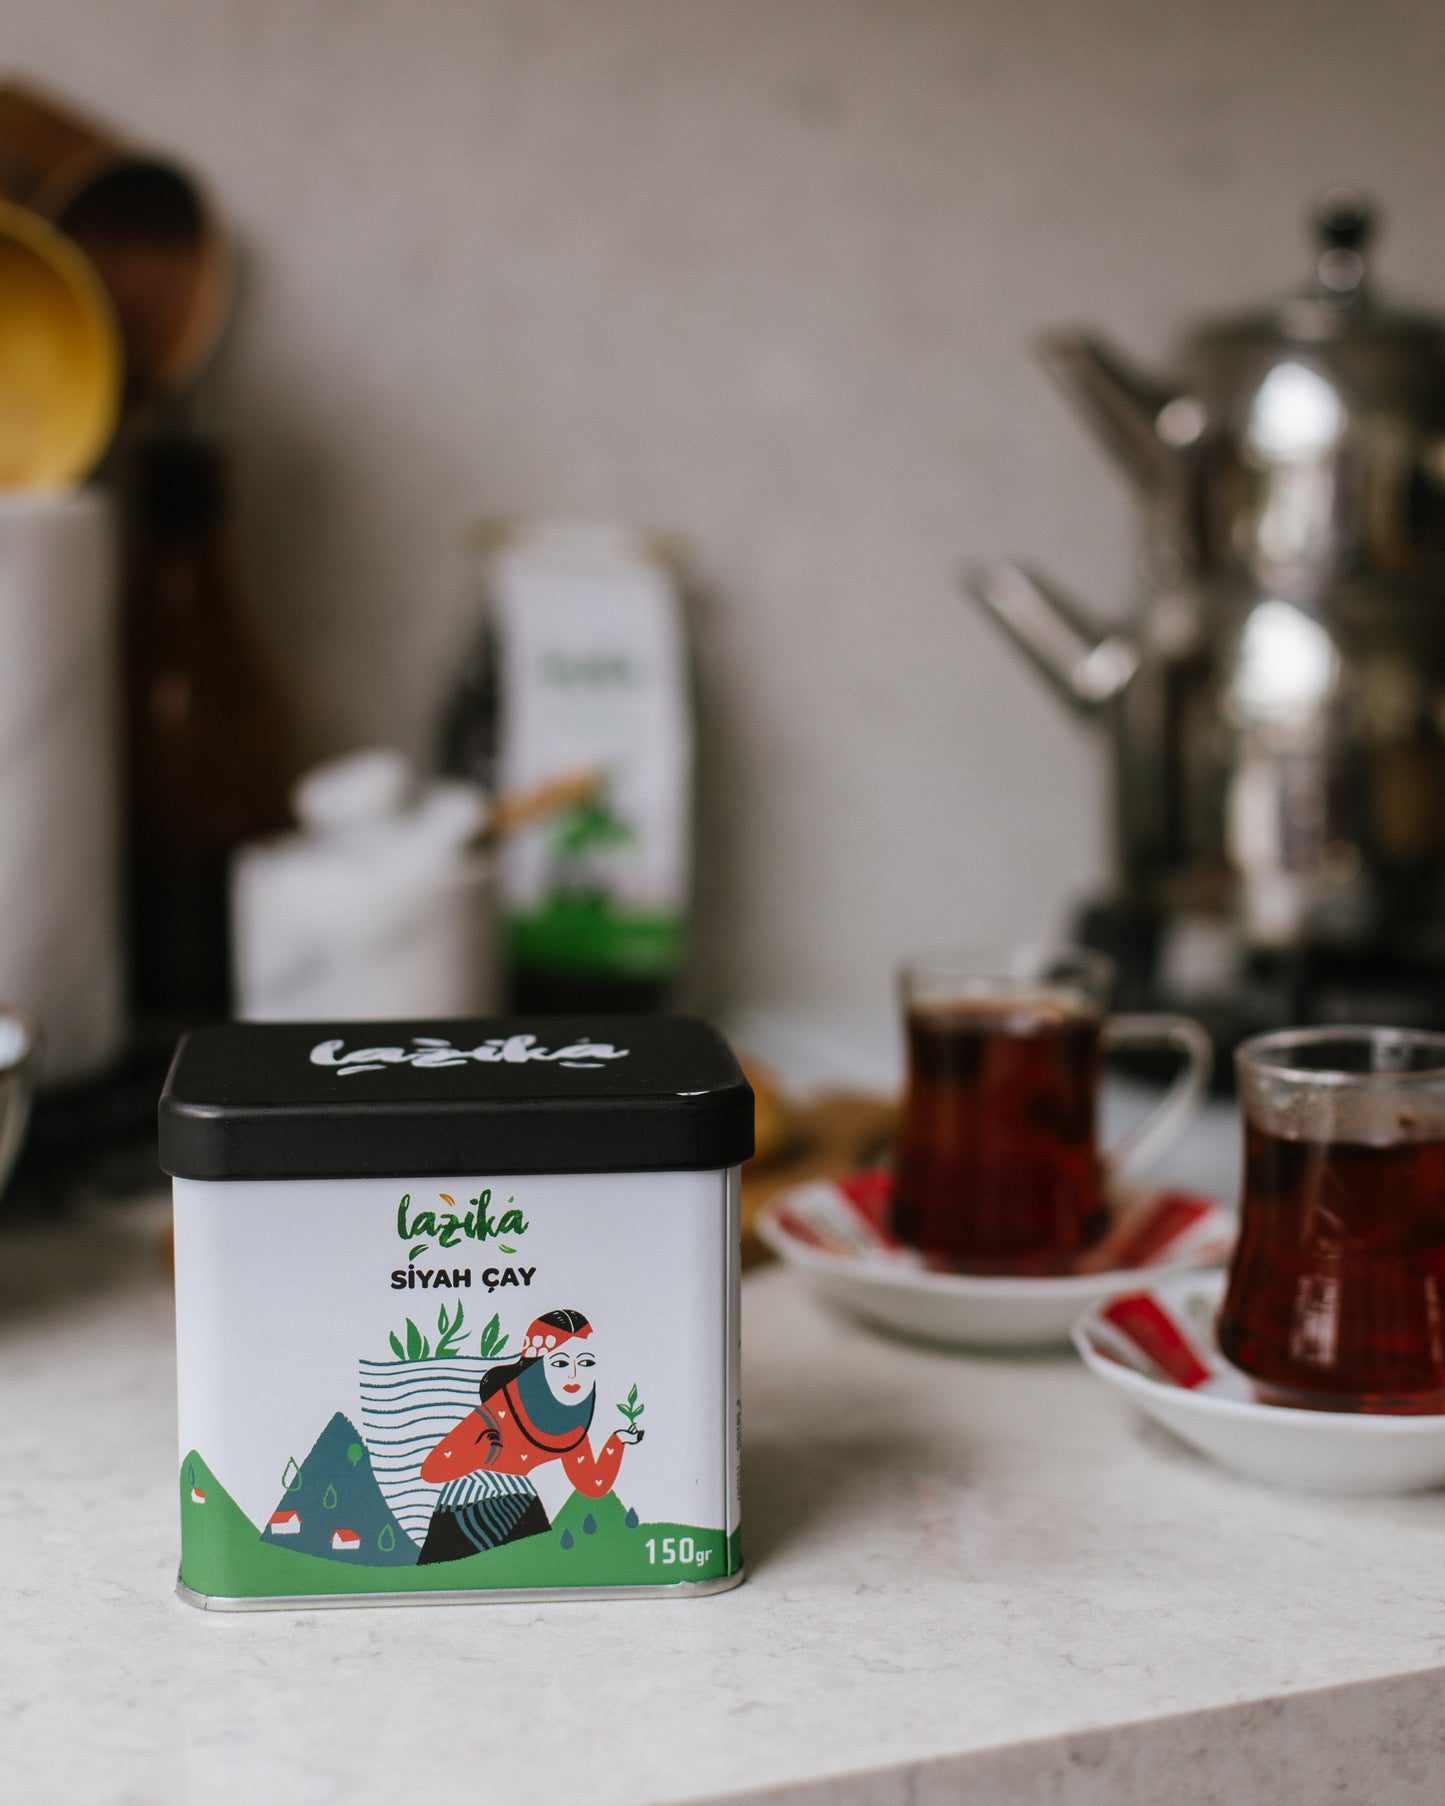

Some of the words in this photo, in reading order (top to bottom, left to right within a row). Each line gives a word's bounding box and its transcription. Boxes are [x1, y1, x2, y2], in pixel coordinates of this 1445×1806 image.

[390, 1263, 472, 1290] SİYAH
[481, 1266, 537, 1293] ÇAY
[645, 1537, 713, 1567] 150gr
